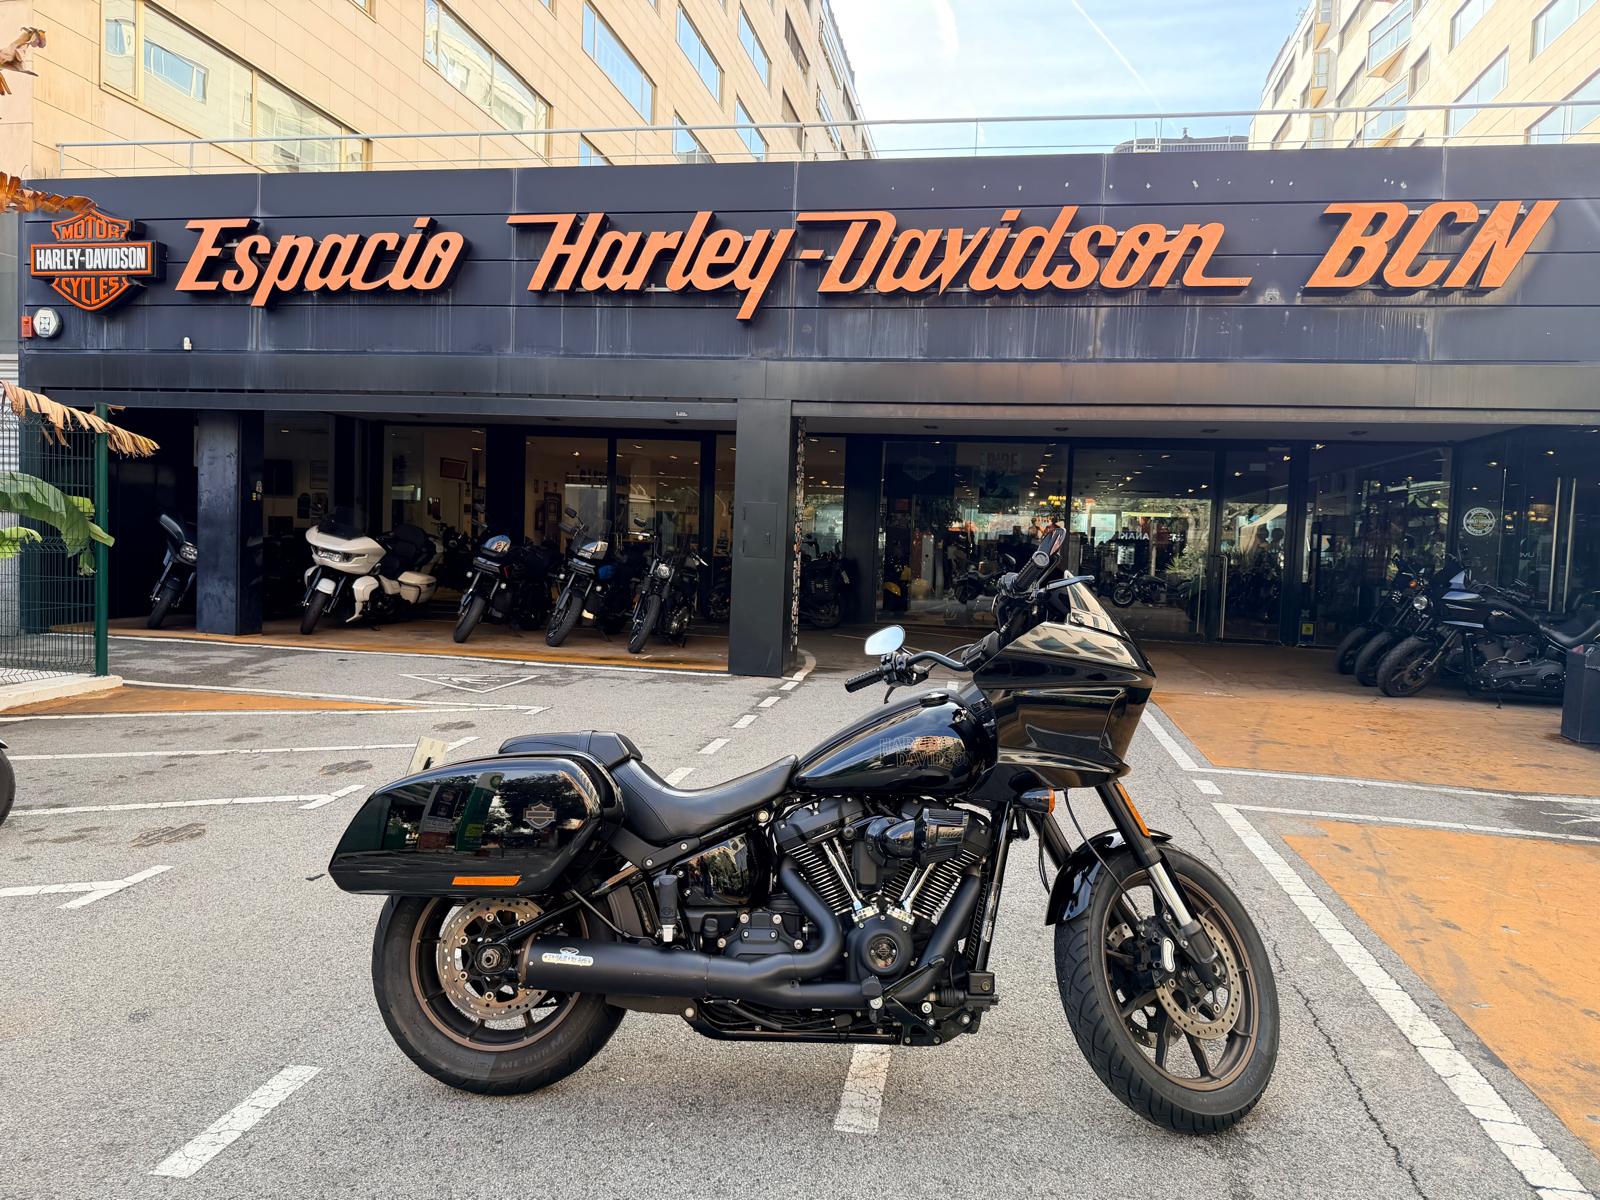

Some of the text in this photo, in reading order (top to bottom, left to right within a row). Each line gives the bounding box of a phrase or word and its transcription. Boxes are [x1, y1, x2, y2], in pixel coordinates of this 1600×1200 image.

[62, 216, 121, 240] MOTOR
[37, 247, 147, 271] HARLEY-DAVIDSON
[176, 200, 1558, 321] Espacio Harley-Davidson BCN
[61, 276, 121, 305] CYCLES
[896, 750, 974, 768] DAVIDSON
